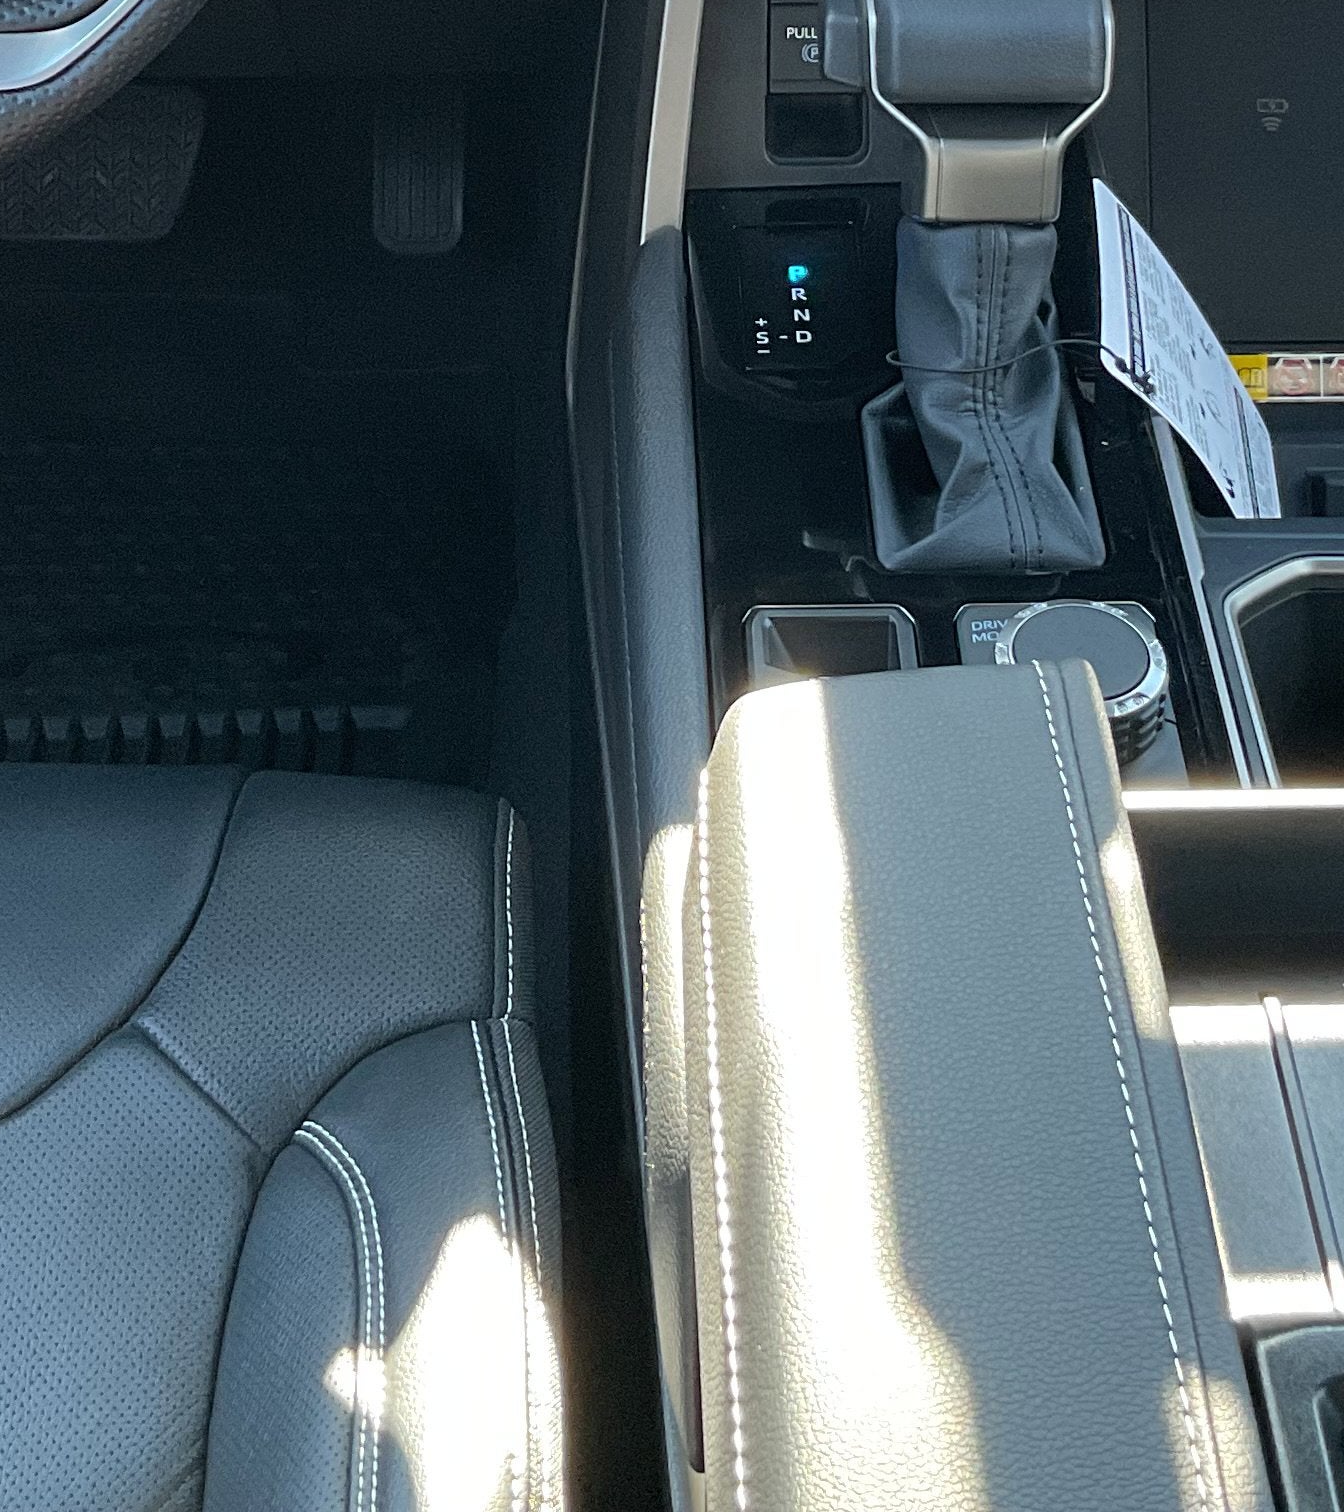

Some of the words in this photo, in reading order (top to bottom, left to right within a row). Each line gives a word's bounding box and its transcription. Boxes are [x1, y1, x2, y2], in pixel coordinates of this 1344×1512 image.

[786, 27, 818, 39] PULL
[788, 266, 808, 283] P
[791, 288, 807, 301] R
[793, 309, 811, 321] N
[756, 331, 769, 344] S
[796, 331, 812, 343] D
[971, 619, 1008, 631] DRIV
[972, 631, 999, 643] MO
